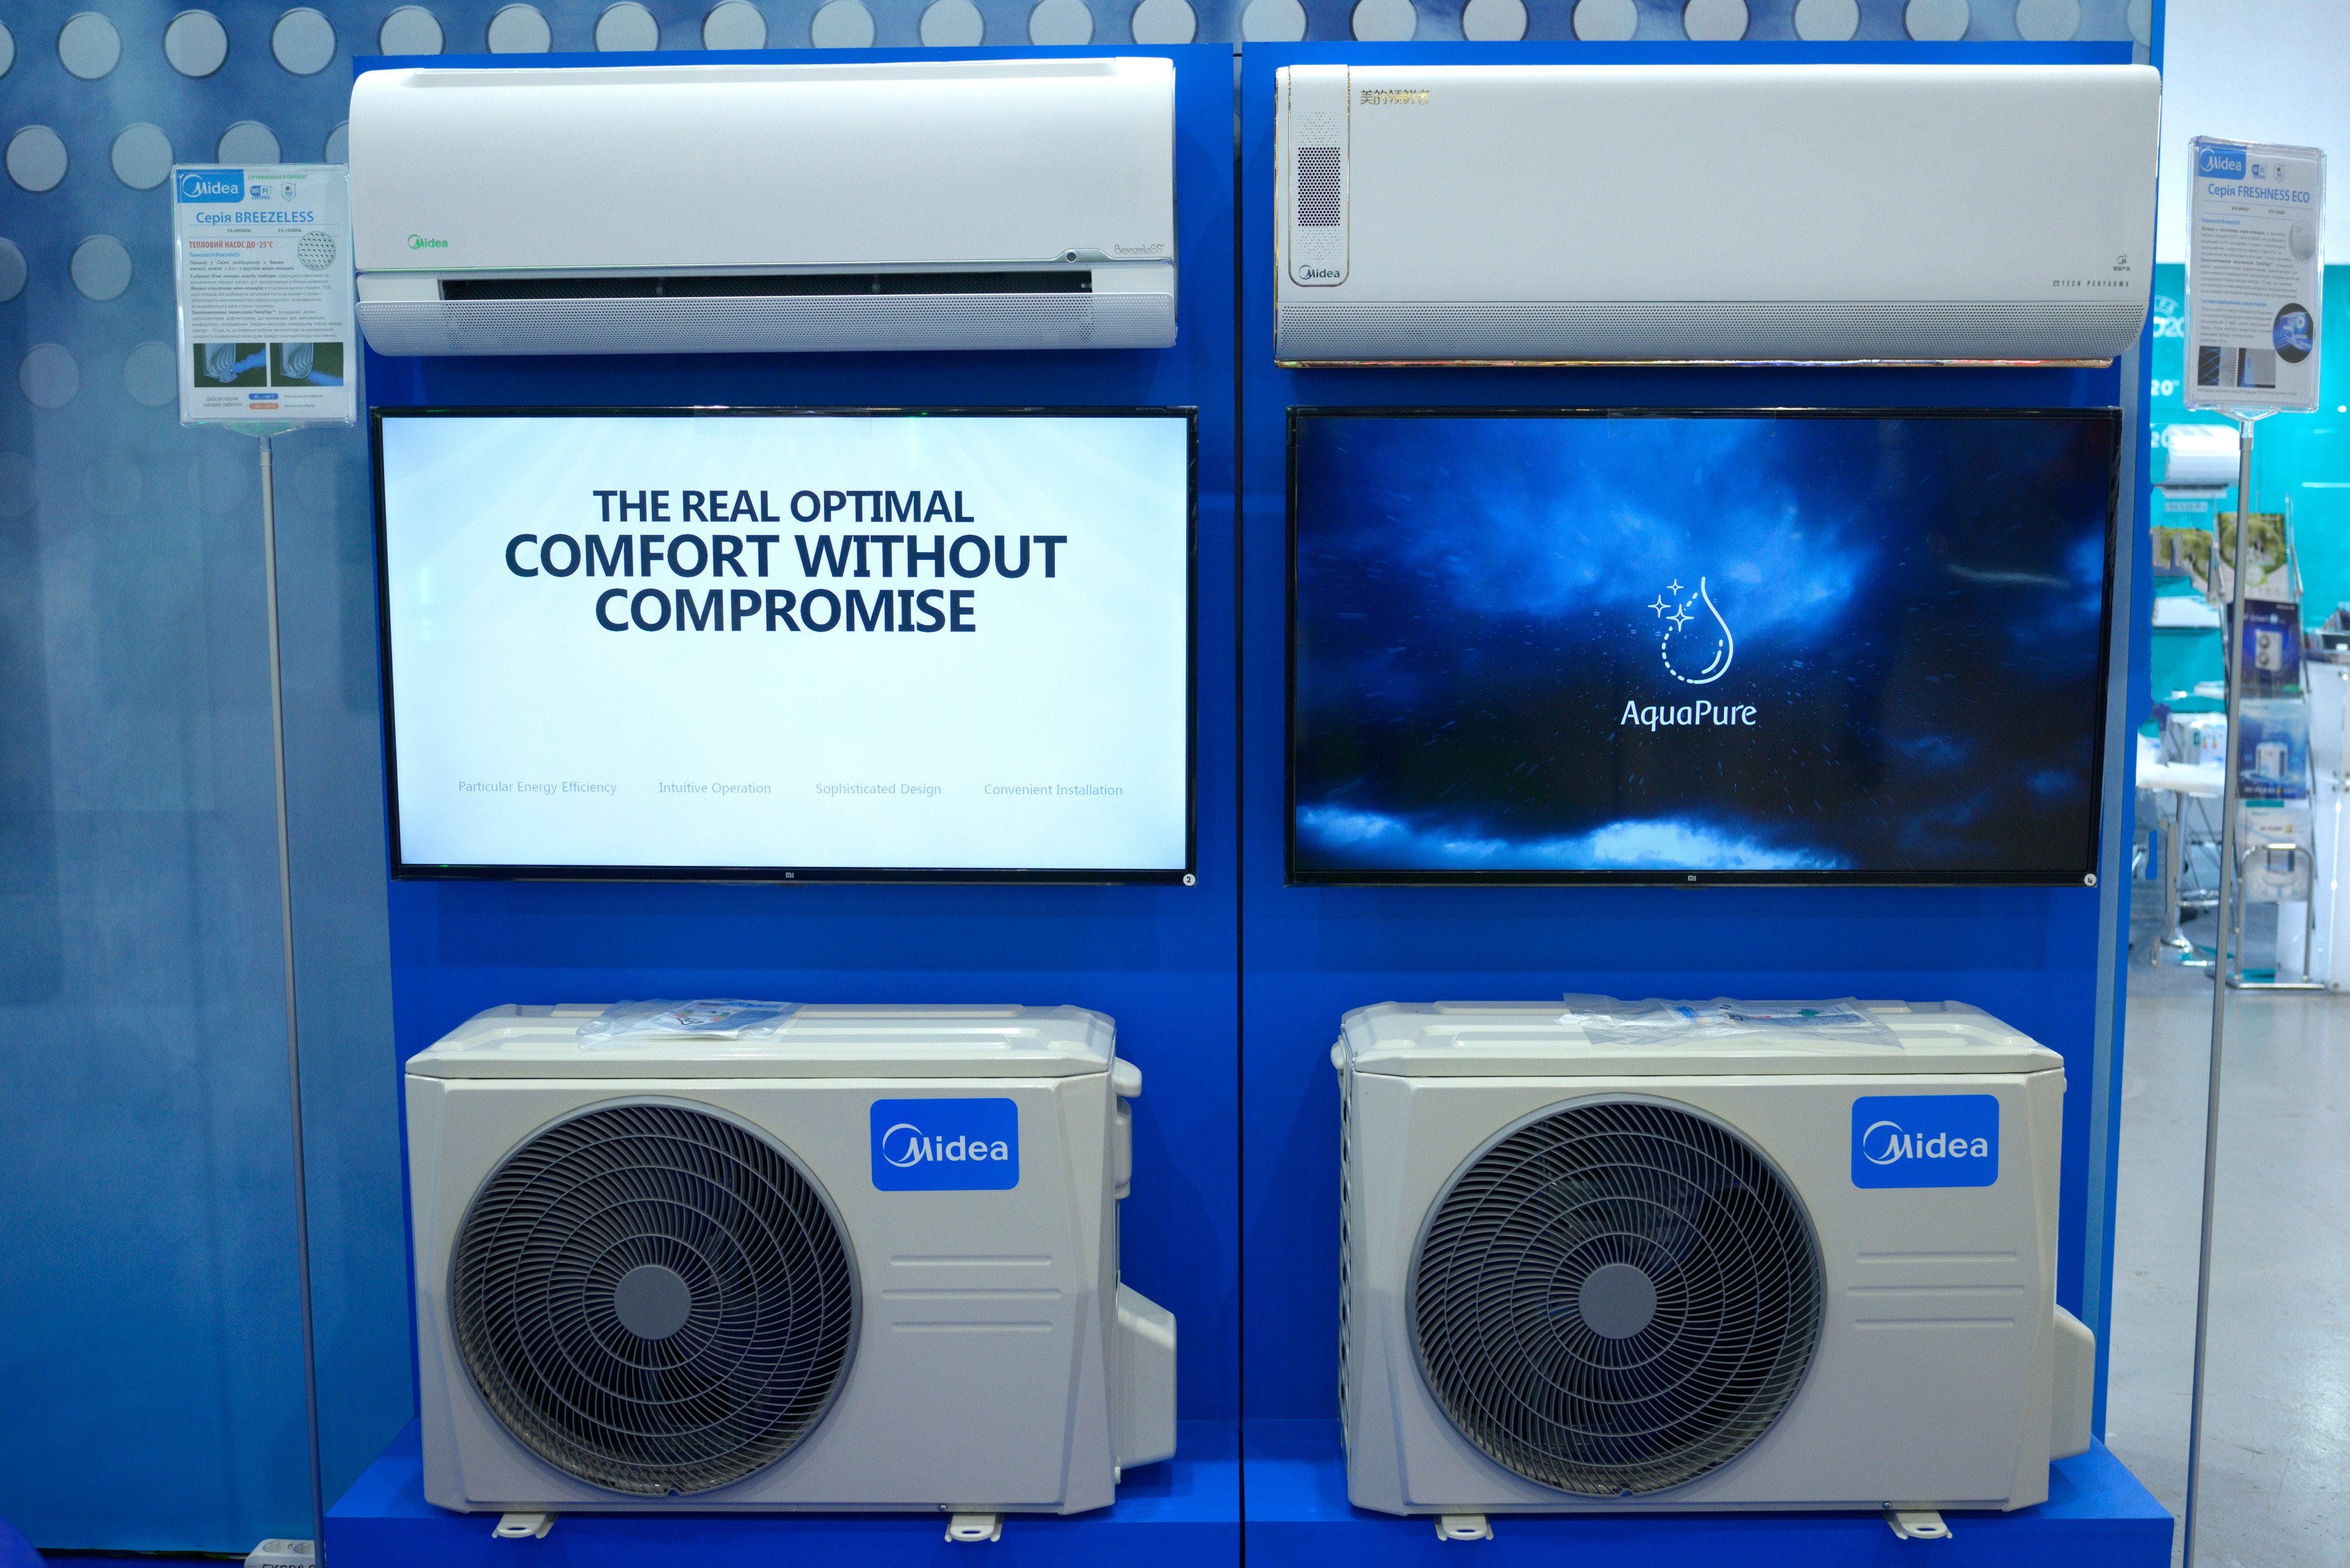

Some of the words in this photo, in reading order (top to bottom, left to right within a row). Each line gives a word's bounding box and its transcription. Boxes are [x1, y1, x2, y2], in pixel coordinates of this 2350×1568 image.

[2200, 147, 2242, 172] Midea
[182, 174, 238, 198] Midea
[2208, 184, 2235, 198] Серія
[2238, 186, 2289, 201] FRESHNESS
[2292, 191, 2309, 203] ECO
[196, 212, 231, 225] Серія
[236, 211, 314, 223] BREEZELESS
[189, 240, 223, 248] ТЕПЛОВИЙ
[246, 241, 255, 249] ДО
[407, 234, 448, 250] Midea
[1299, 264, 1340, 279] Midea
[593, 490, 671, 522] THE
[682, 490, 780, 522] REAL
[790, 490, 974, 523] OPTIMAL
[506, 534, 780, 578] COMFORT
[794, 534, 1067, 578] WITHOUT
[596, 588, 976, 632] COMPROMISE
[1621, 700, 1757, 732] AquaPure
[459, 781, 513, 792] Particular
[517, 781, 558, 795] Energy
[562, 781, 617, 796] Efficiency
[659, 781, 708, 793] Intuitive
[712, 782, 771, 796] Operation
[815, 783, 896, 796] Sophisticated
[900, 783, 942, 797] Design
[984, 784, 1053, 796] Convenient
[1056, 784, 1123, 796] Installation
[883, 1123, 1009, 1168] Midea
[1863, 1120, 1988, 1165] Midea
